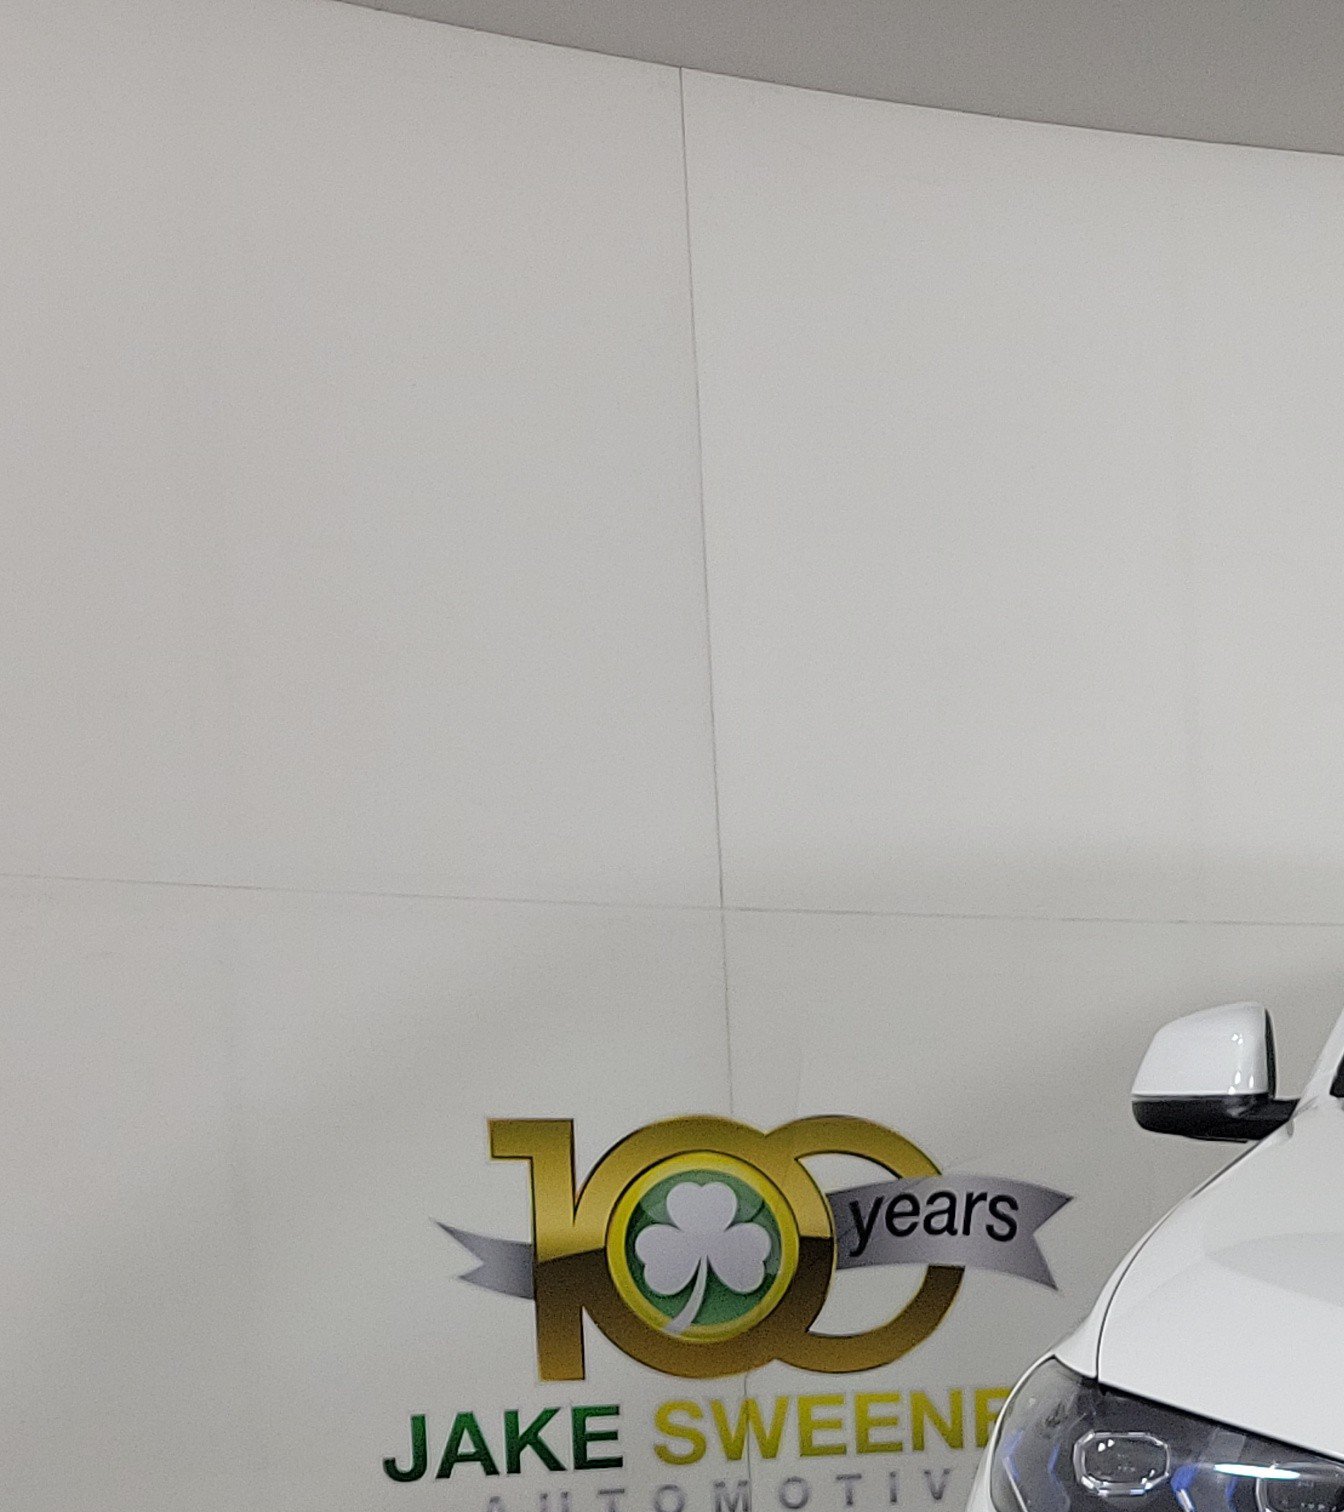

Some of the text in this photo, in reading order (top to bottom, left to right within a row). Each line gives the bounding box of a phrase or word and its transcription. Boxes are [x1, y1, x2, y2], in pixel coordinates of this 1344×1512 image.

[487, 1114, 1020, 1382] 100 years
[381, 1385, 1014, 1483] JAKE SWEENE
